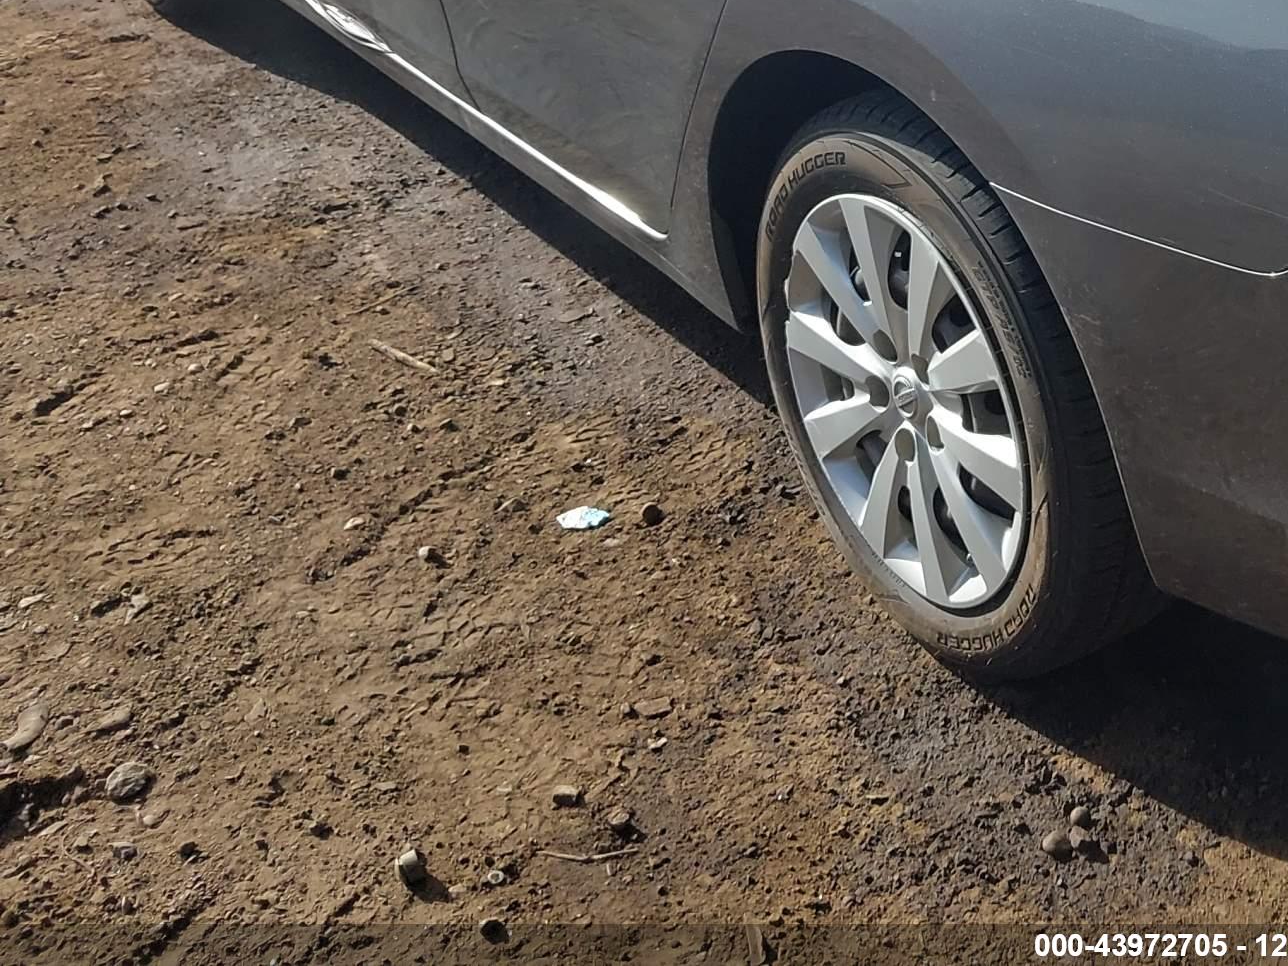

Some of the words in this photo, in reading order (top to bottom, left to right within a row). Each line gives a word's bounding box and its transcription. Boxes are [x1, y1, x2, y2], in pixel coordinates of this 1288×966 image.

[765, 183, 789, 242] ROAD
[787, 151, 847, 190] HUGGER
[1004, 583, 1037, 636] ROAD
[937, 628, 1005, 650] HUGGER
